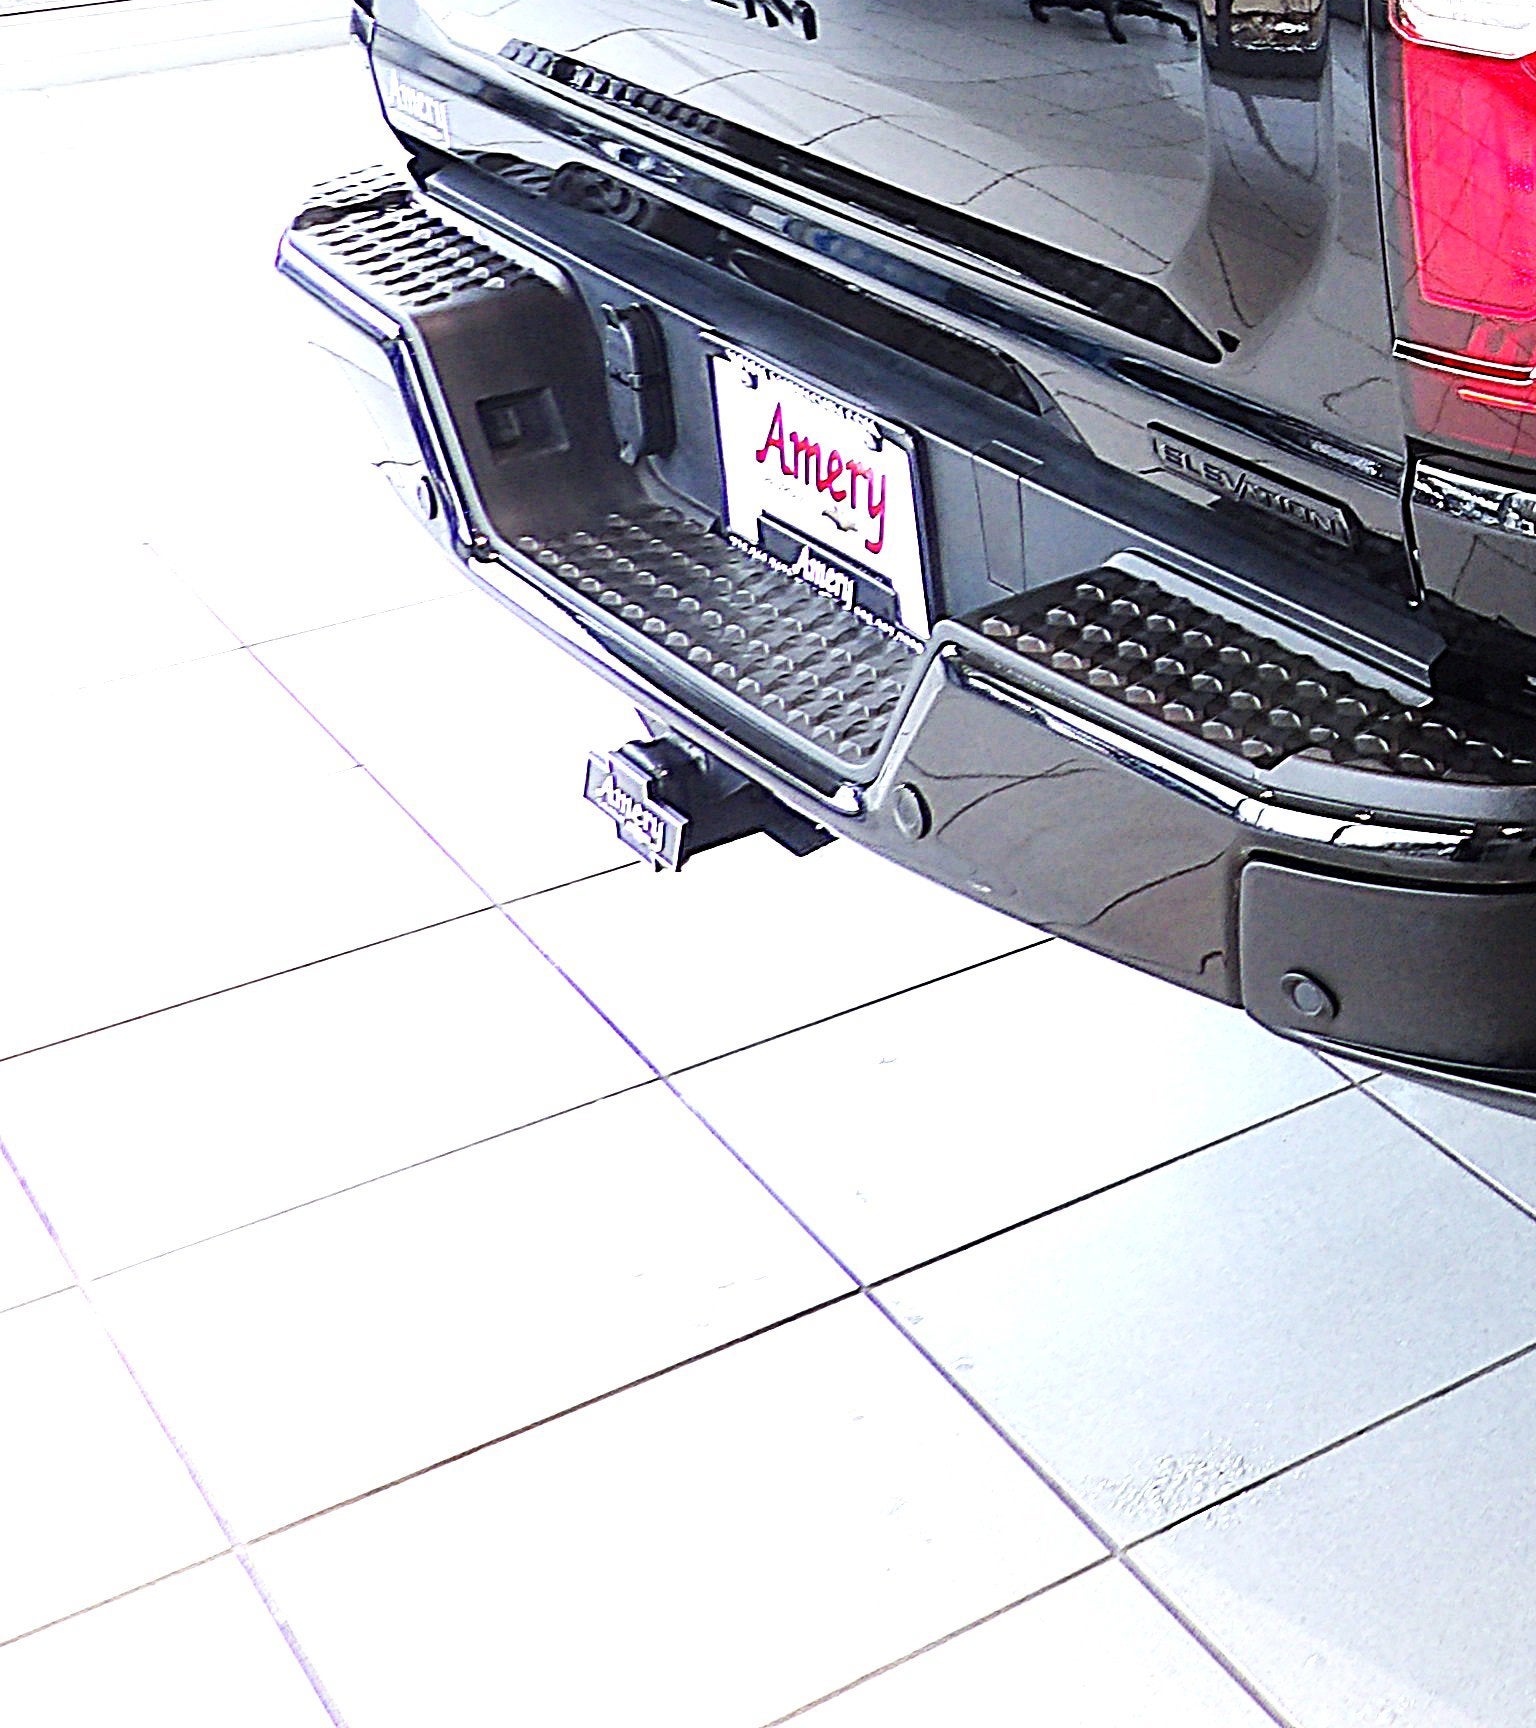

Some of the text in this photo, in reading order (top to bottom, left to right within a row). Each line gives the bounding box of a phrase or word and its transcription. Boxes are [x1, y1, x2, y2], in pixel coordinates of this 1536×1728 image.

[755, 401, 886, 555] Amery
[1156, 442, 1344, 539] ELEVATION
[790, 544, 856, 611] Amery
[595, 773, 667, 853] Amery
